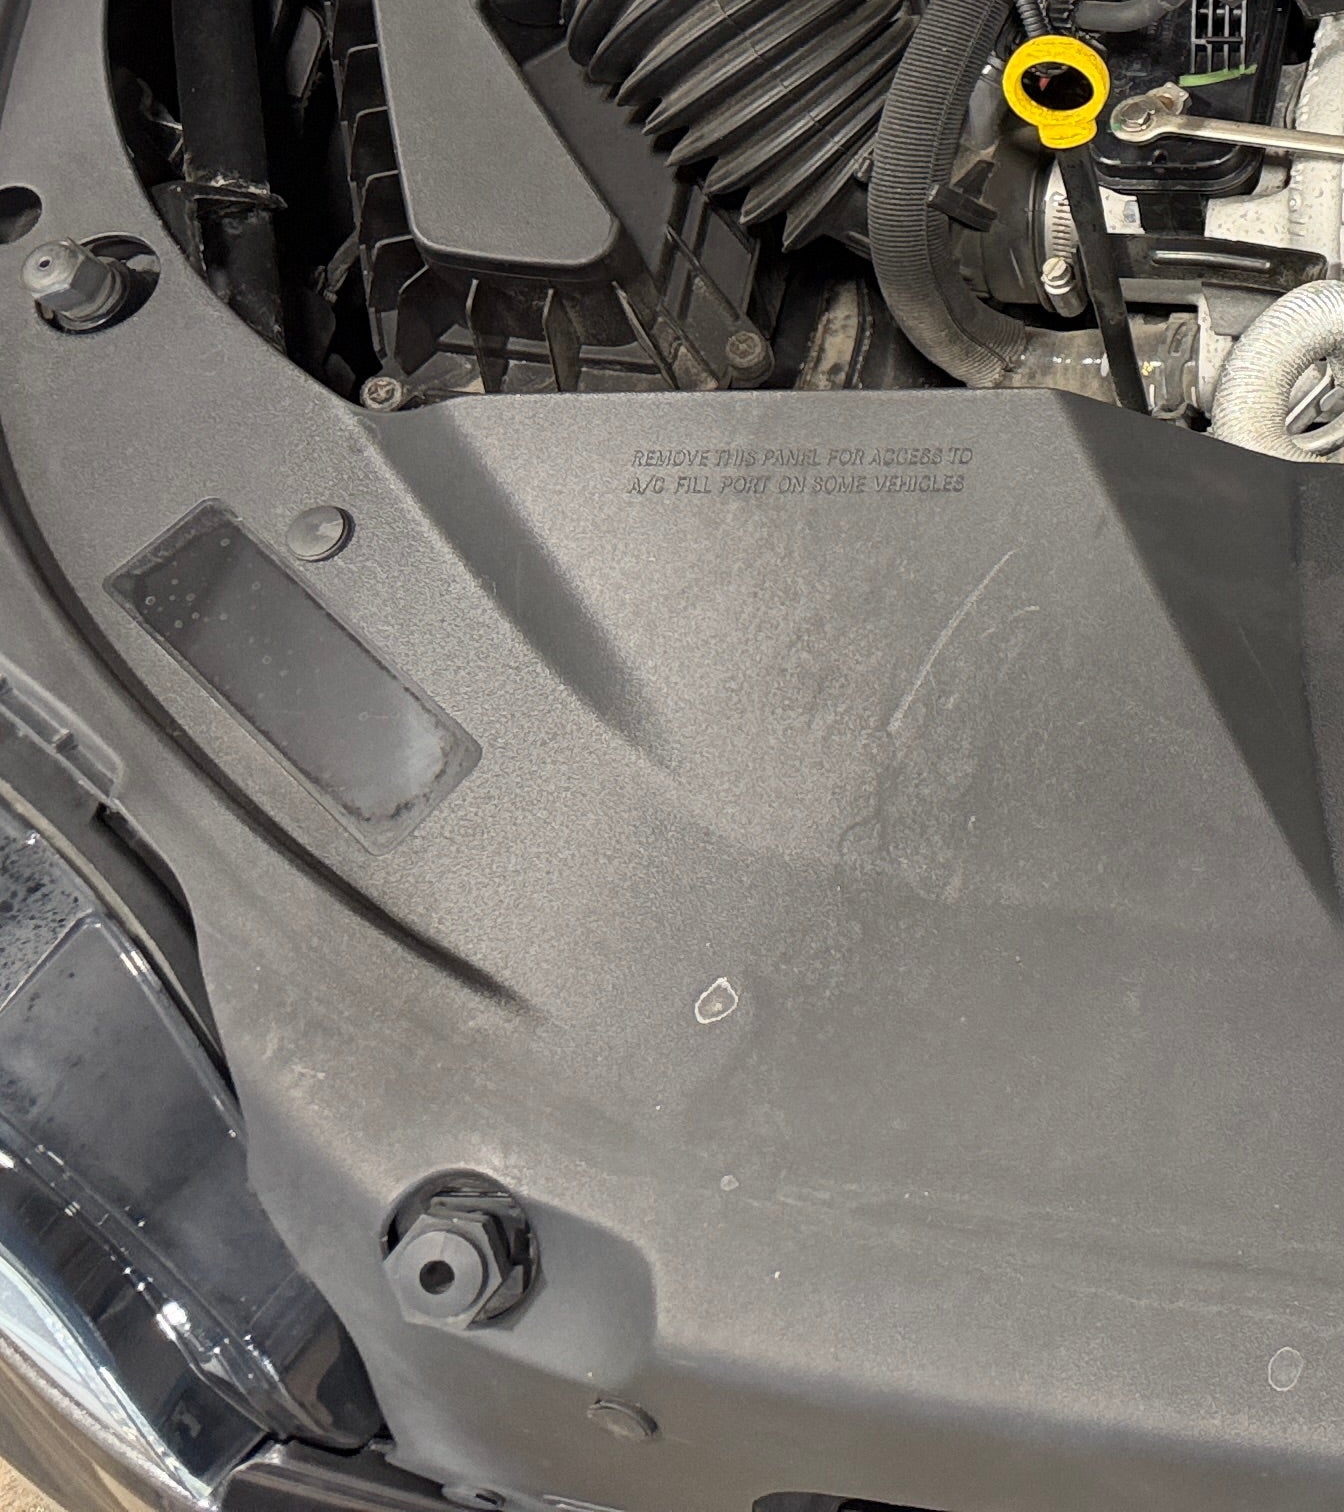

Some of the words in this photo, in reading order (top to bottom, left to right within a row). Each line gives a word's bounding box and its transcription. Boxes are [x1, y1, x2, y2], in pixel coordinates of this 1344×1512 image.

[631, 448, 711, 468] REMOVE
[715, 448, 757, 467] THIS
[761, 448, 820, 467] PANEL
[827, 447, 866, 467] FOR
[868, 447, 944, 467] ACCESS
[947, 447, 975, 466] TO
[627, 475, 666, 495] A/C
[673, 475, 713, 494] FILL
[720, 475, 770, 494] PORT
[777, 474, 807, 494] ON
[811, 474, 867, 494] SOME
[872, 473, 966, 494] VEHICLES
